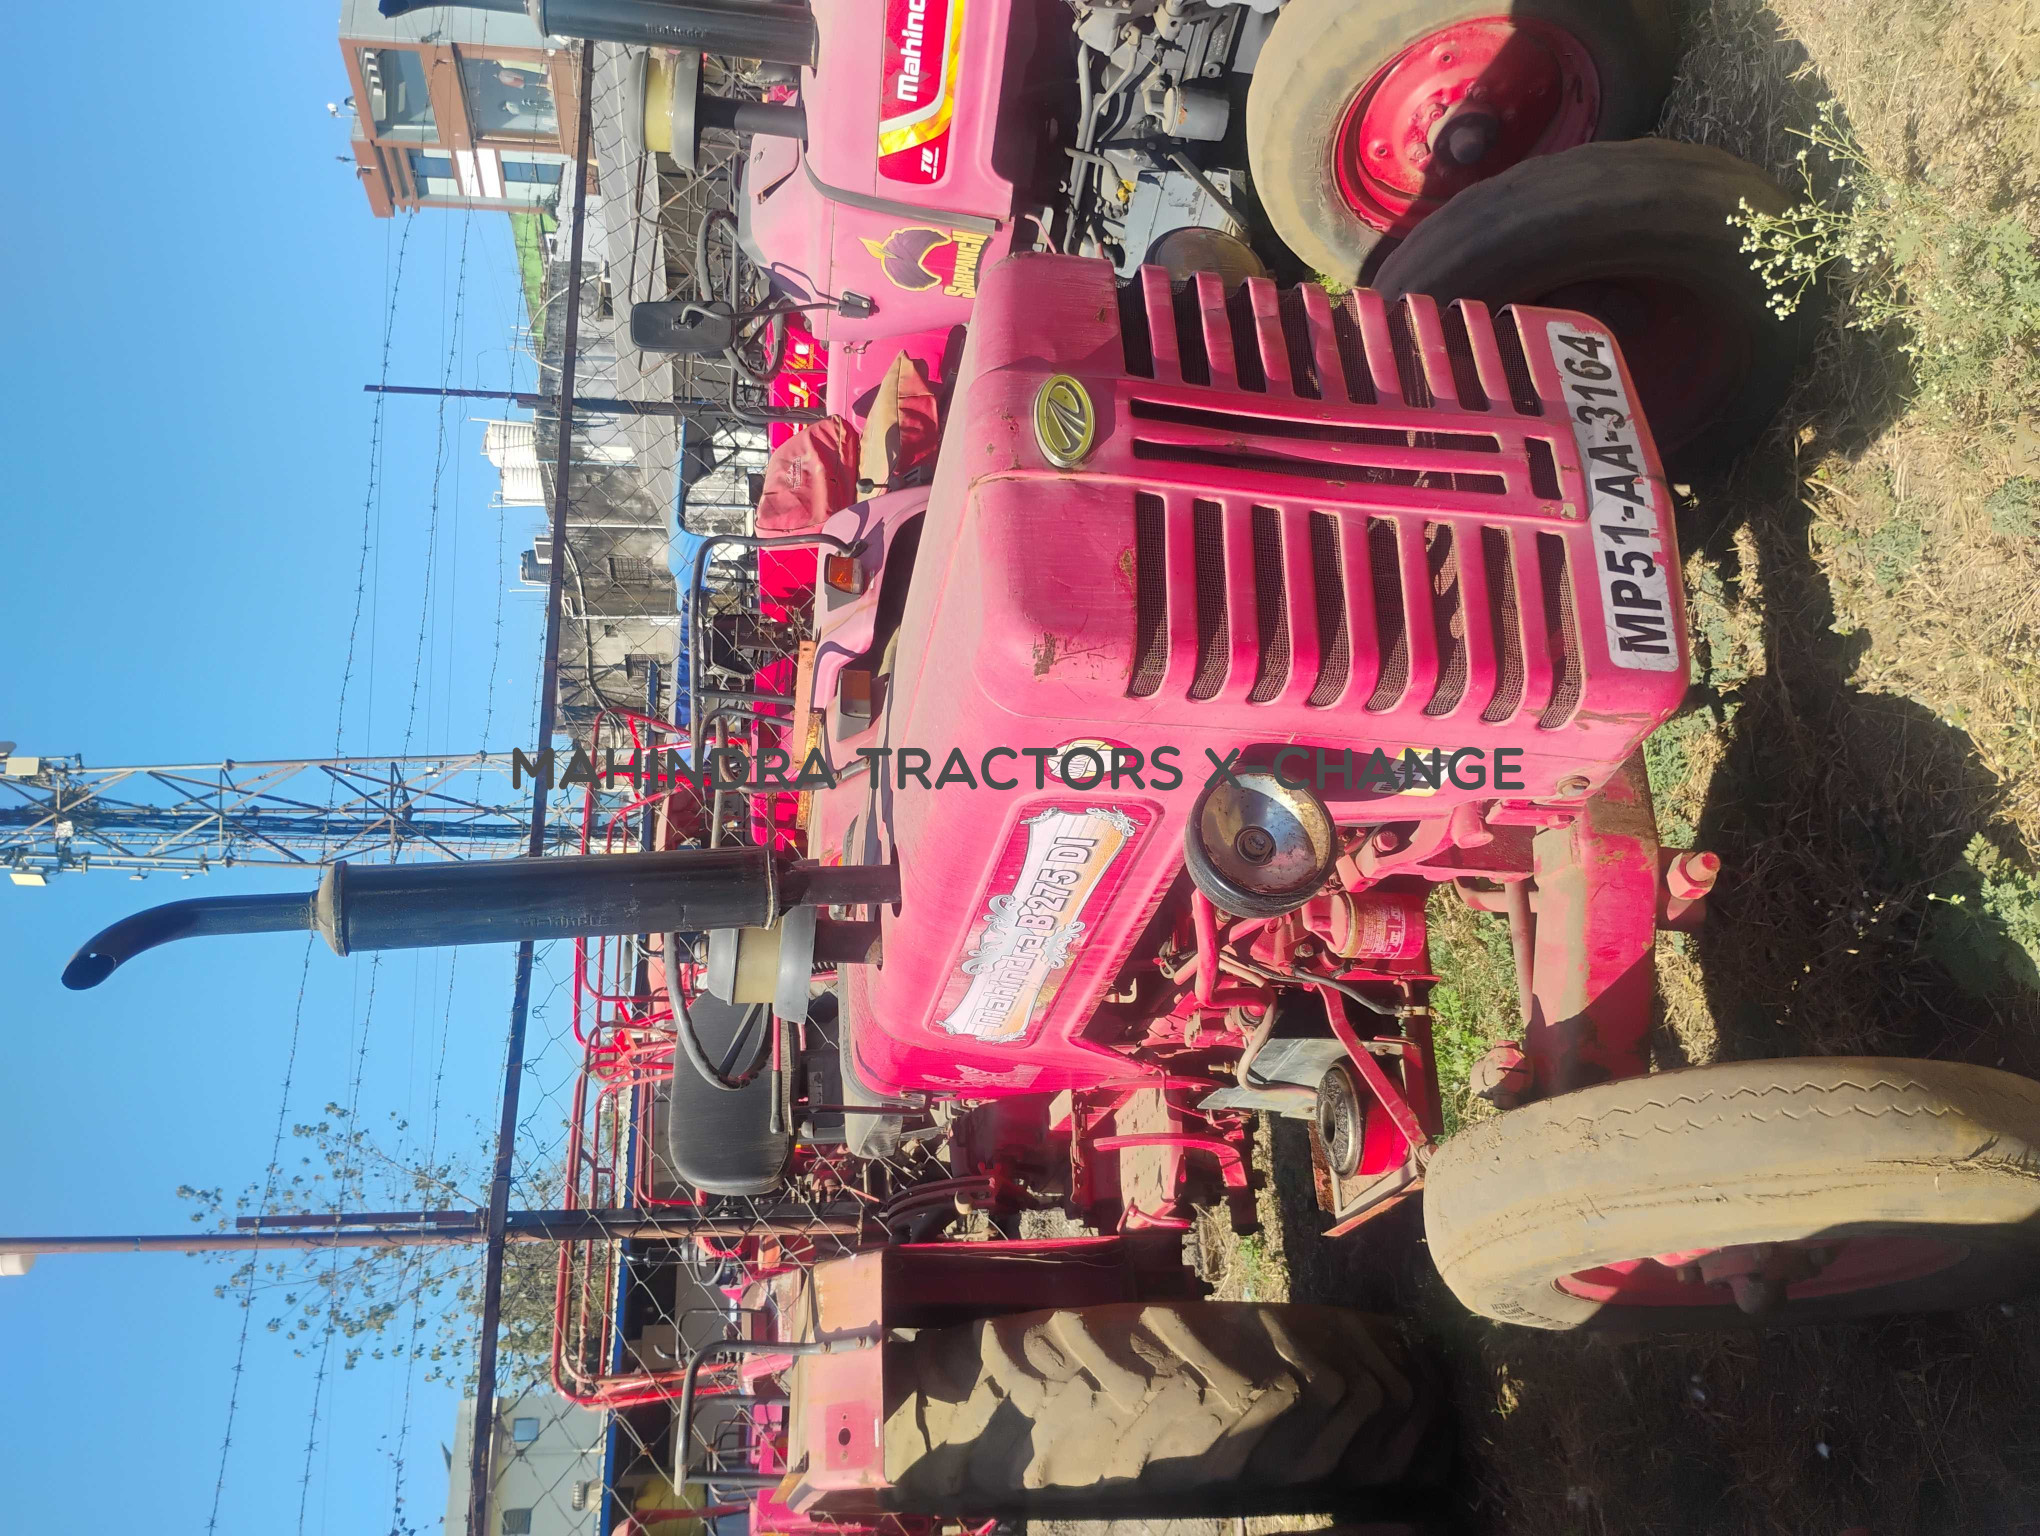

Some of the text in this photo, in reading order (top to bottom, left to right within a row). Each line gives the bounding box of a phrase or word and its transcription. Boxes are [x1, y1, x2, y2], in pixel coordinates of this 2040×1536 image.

[921, 147, 933, 174] TU
[943, 230, 989, 299] SARPANCH
[1558, 333, 1670, 655] MP51-AA-3164
[1047, 836, 1098, 865] DI
[1025, 868, 1081, 912] 275
[1015, 914, 1057, 931] B
[969, 934, 1046, 1028] Mahindra
